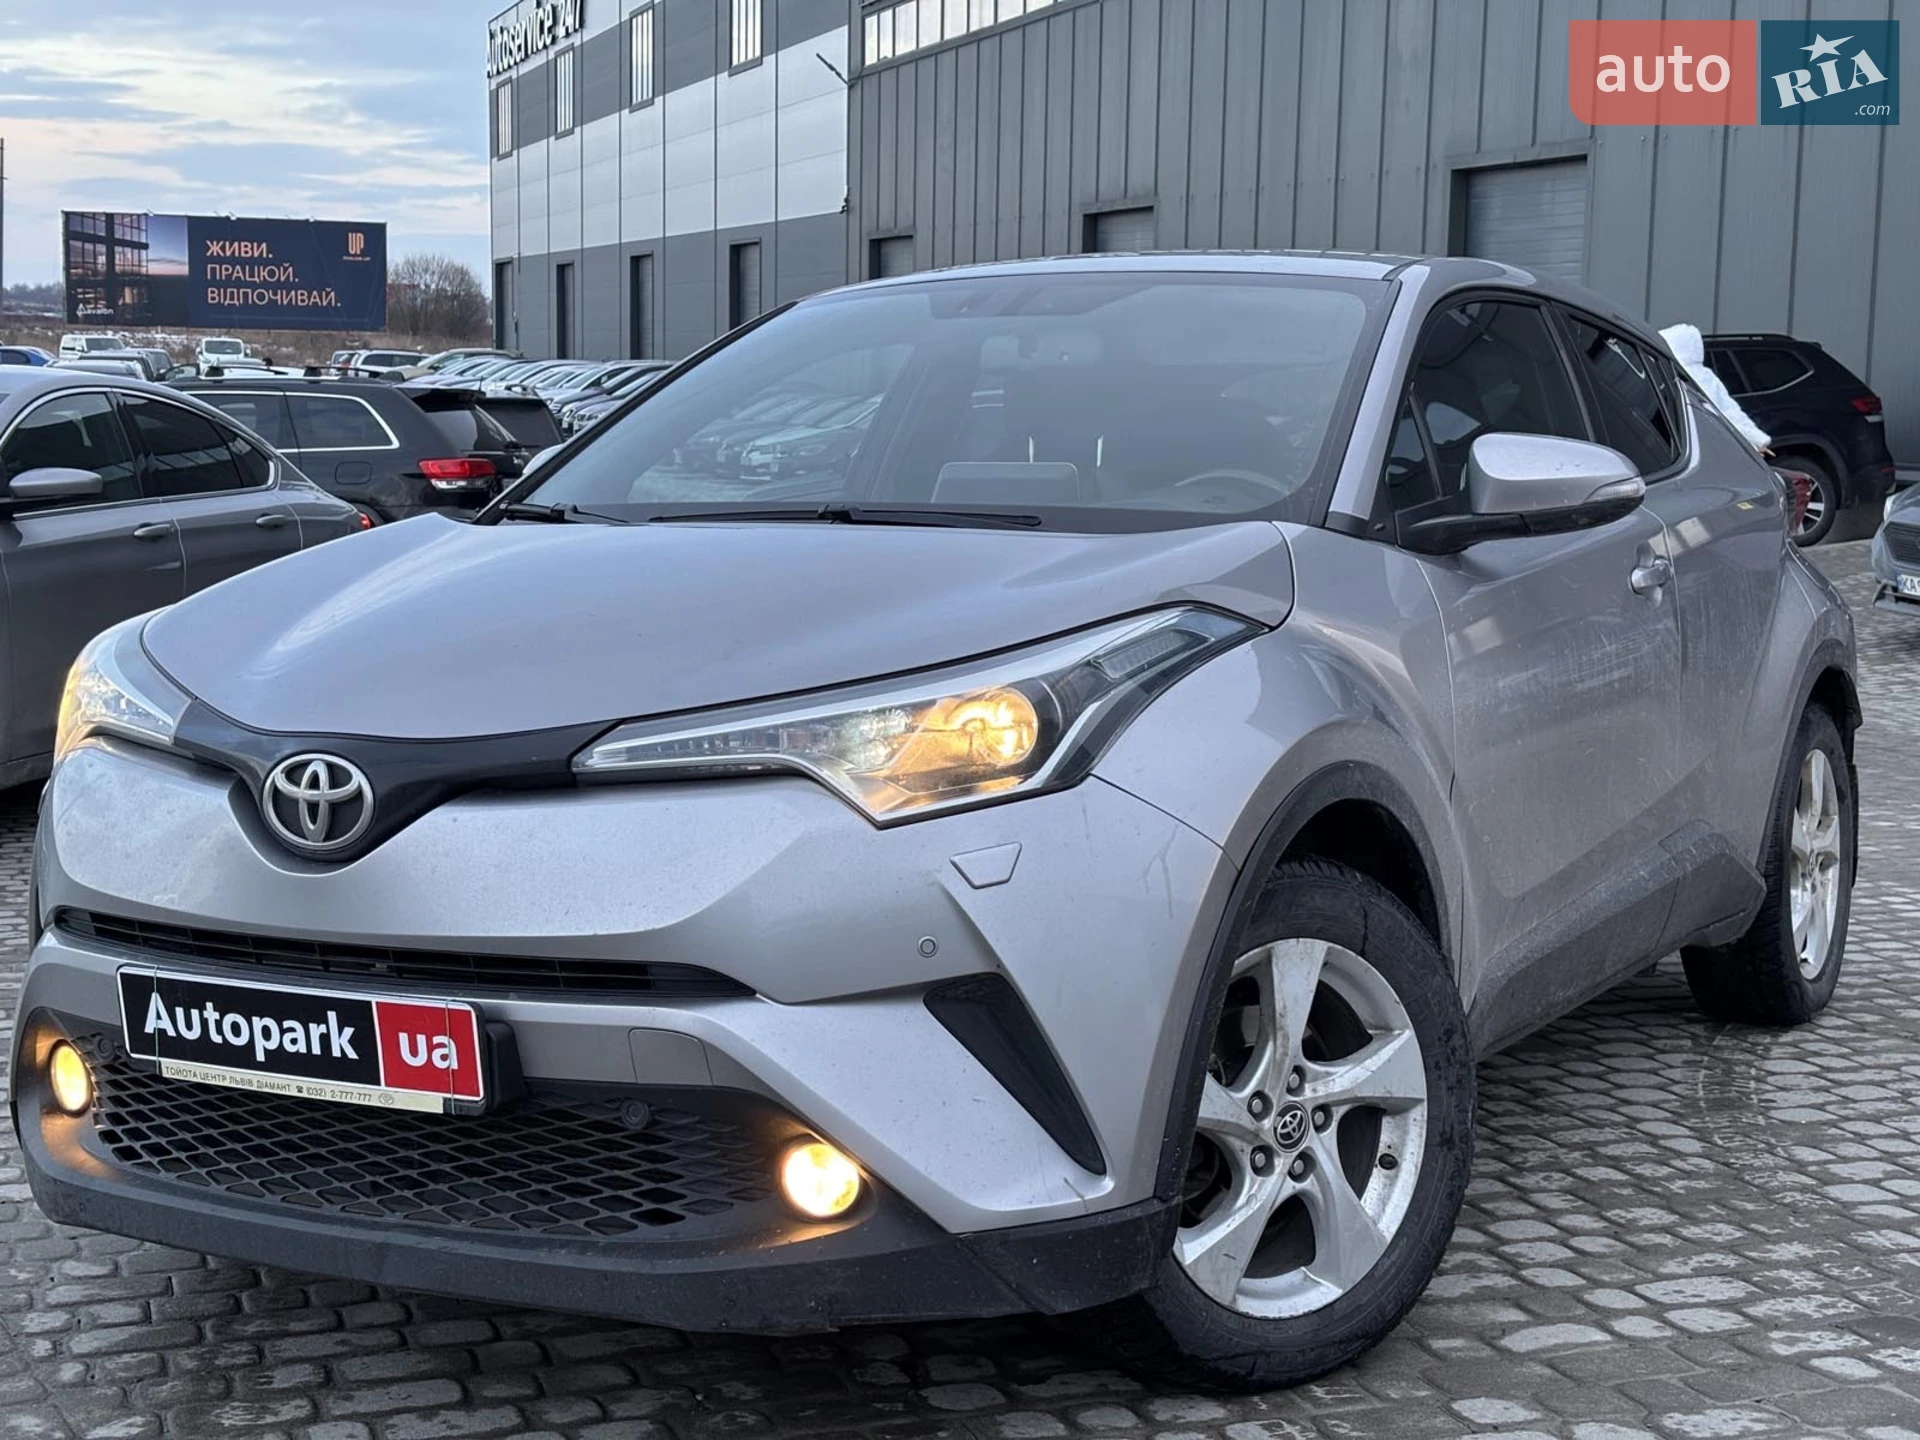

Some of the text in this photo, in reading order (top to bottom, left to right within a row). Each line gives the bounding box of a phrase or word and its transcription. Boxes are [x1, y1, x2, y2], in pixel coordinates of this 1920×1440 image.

[487, 0, 553, 78] Autoservice
[205, 239, 274, 259] ЖИВИ.
[348, 231, 365, 255] UP
[206, 261, 300, 284] ПРАЦЮЙ.
[206, 286, 342, 307] ВІДПОЧИВАЙ.
[144, 991, 460, 1071] Autopark ua
[165, 1066, 372, 1102] ТОЙОТА ЦЕНТР ЛЬВІВ ДІАМАНТ (032) 2-777-777
